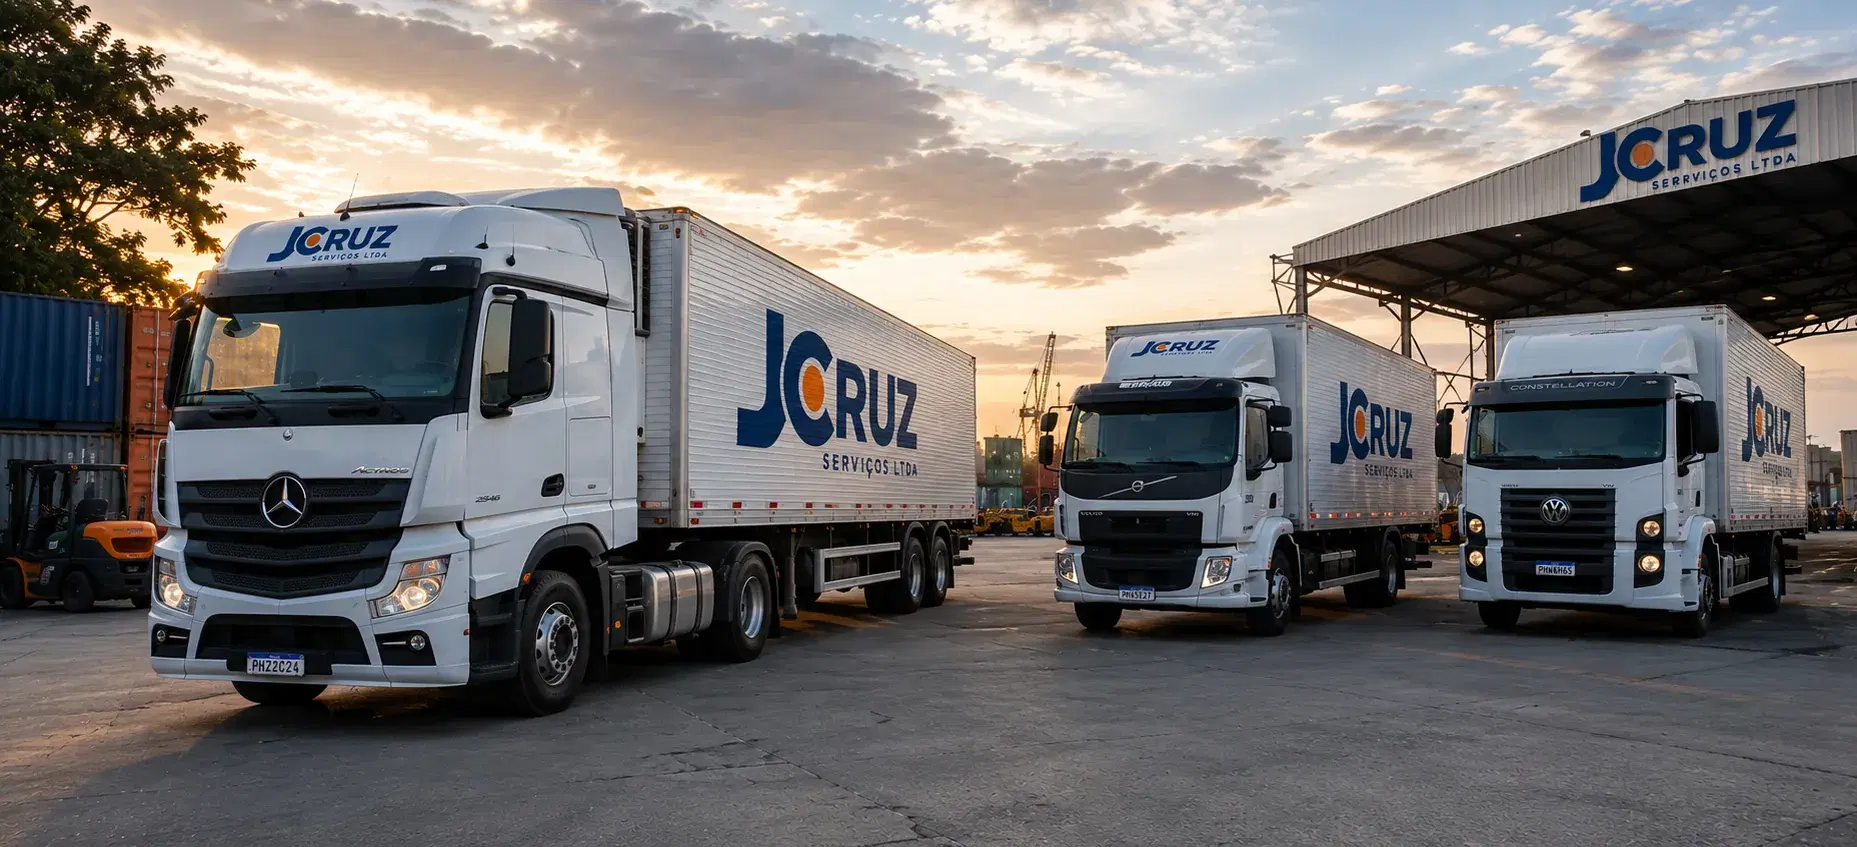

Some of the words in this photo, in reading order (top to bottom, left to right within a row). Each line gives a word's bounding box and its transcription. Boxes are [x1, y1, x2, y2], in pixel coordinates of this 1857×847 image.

[1579, 99, 1797, 203] JCRUZ
[1751, 152, 1796, 170] LTDA
[266, 225, 398, 262] JCRUZ
[312, 252, 359, 261] SERVIÇOS
[1130, 340, 1220, 357] JCRUZ
[736, 308, 918, 449] JCRUZ
[1510, 381, 1616, 391] CONSTELLATION
[1330, 381, 1413, 465] JCRUZ
[1741, 376, 1792, 462] JCRUZ
[822, 453, 889, 478] SERVIÇOS
[894, 461, 918, 476] LTDA
[252, 660, 299, 673] PHZ2C24
